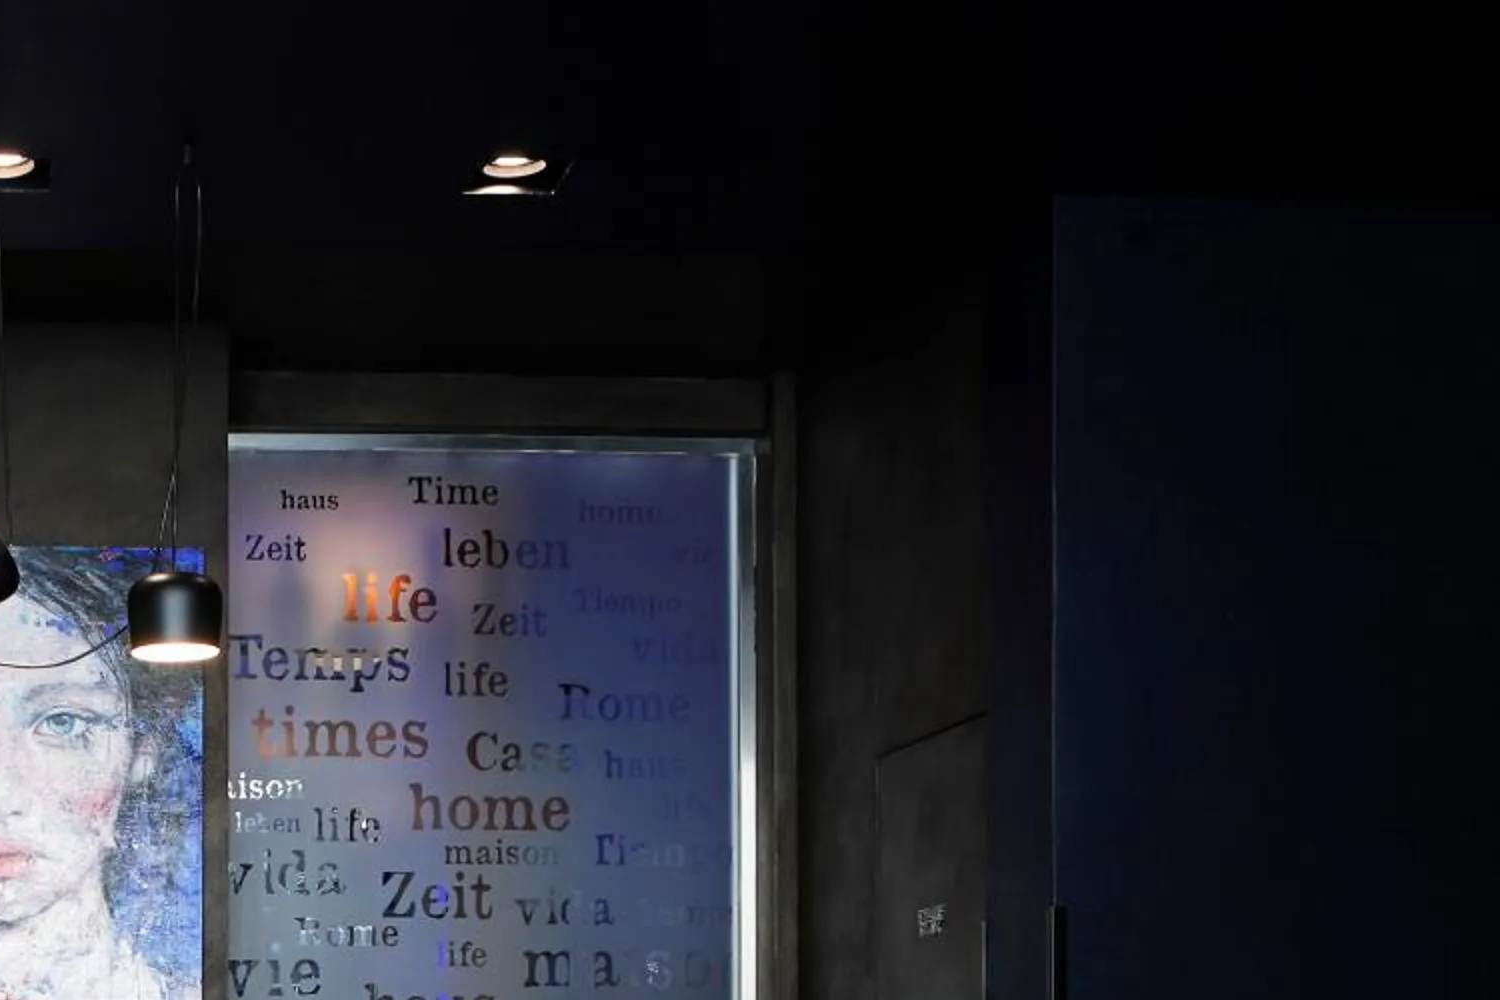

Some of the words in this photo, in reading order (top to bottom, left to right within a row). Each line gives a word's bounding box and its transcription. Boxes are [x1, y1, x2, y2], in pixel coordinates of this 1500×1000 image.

[280, 489, 340, 511] haus
[408, 475, 499, 506] Time
[245, 533, 307, 562] Zeit
[443, 527, 572, 571] leben
[341, 570, 439, 624] life
[472, 602, 548, 638] Zeit
[229, 633, 411, 692] Temps
[445, 661, 509, 697] life
[556, 680, 692, 723] Rome
[252, 705, 430, 760] times
[313, 807, 381, 843] life
[408, 782, 571, 833] home
[230, 848, 348, 896] vida
[444, 838, 559, 867] maison
[381, 871, 494, 920] Zeit
[514, 888, 616, 928] vida
[294, 916, 399, 948] Rome
[228, 942, 321, 998] vie
[436, 941, 488, 968] life
